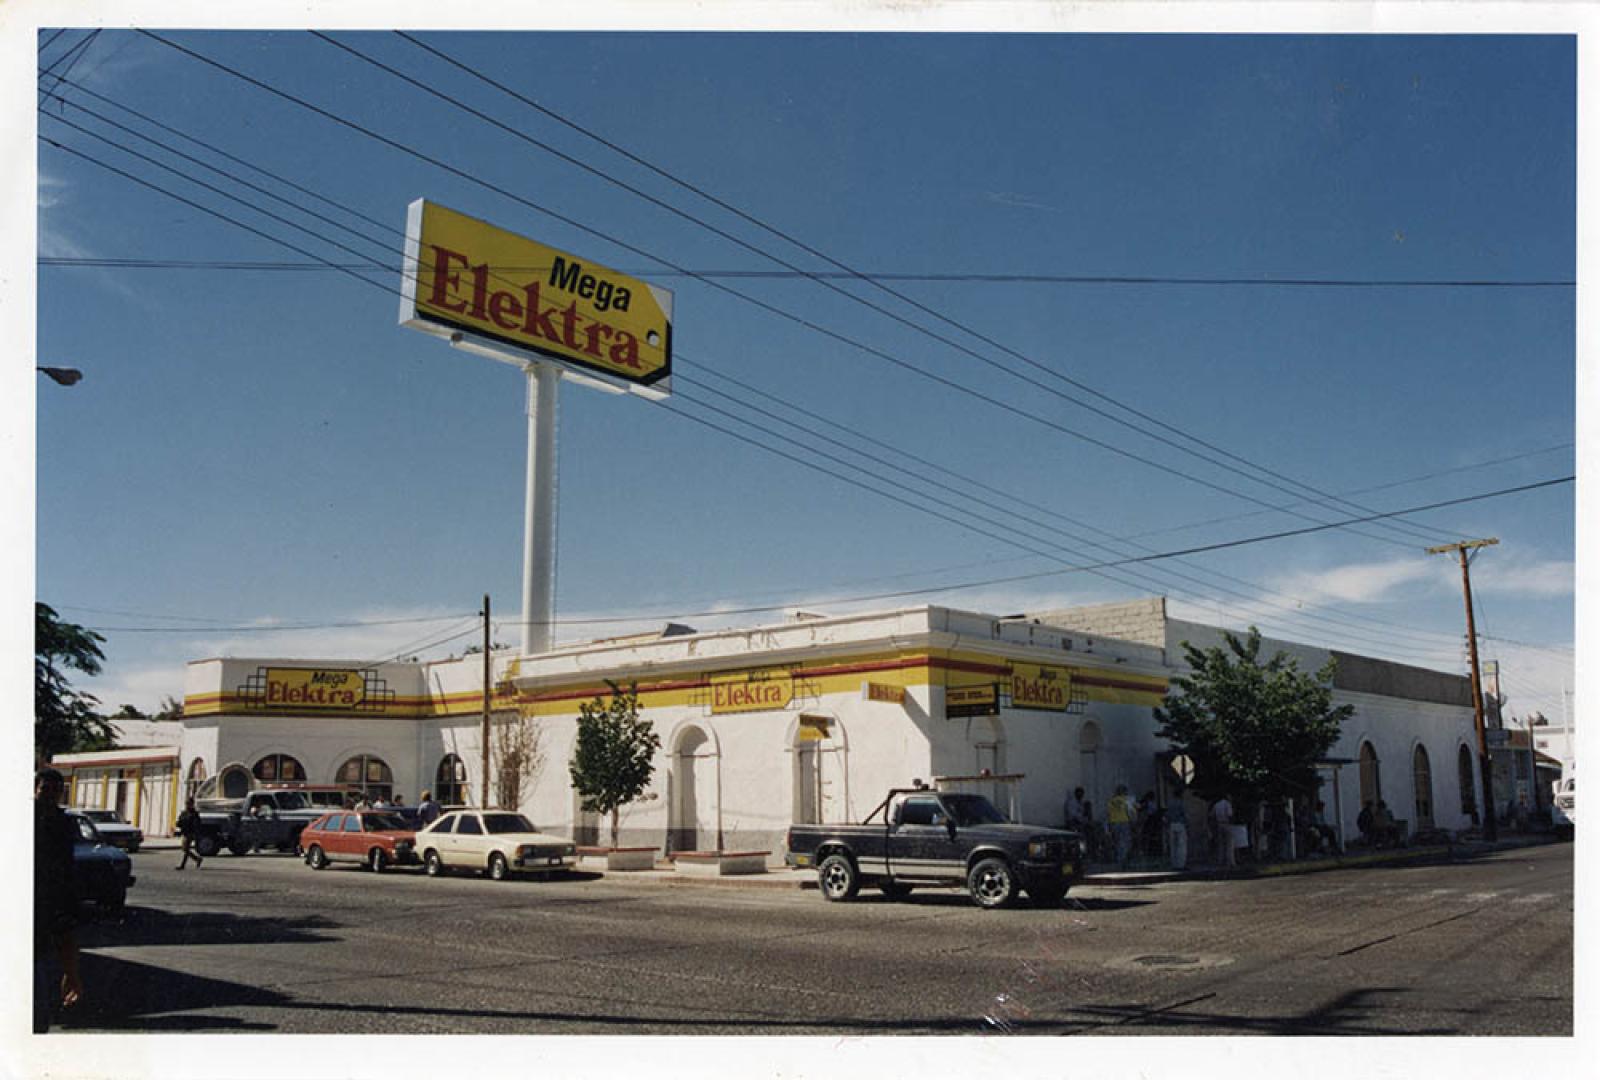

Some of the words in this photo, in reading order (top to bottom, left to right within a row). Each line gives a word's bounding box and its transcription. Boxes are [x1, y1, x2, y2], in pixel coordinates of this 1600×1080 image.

[549, 256, 631, 312] Mega
[427, 245, 642, 369] Elektra
[311, 671, 348, 688] Mega
[268, 680, 355, 704] Elektra
[714, 682, 781, 706] Elektra
